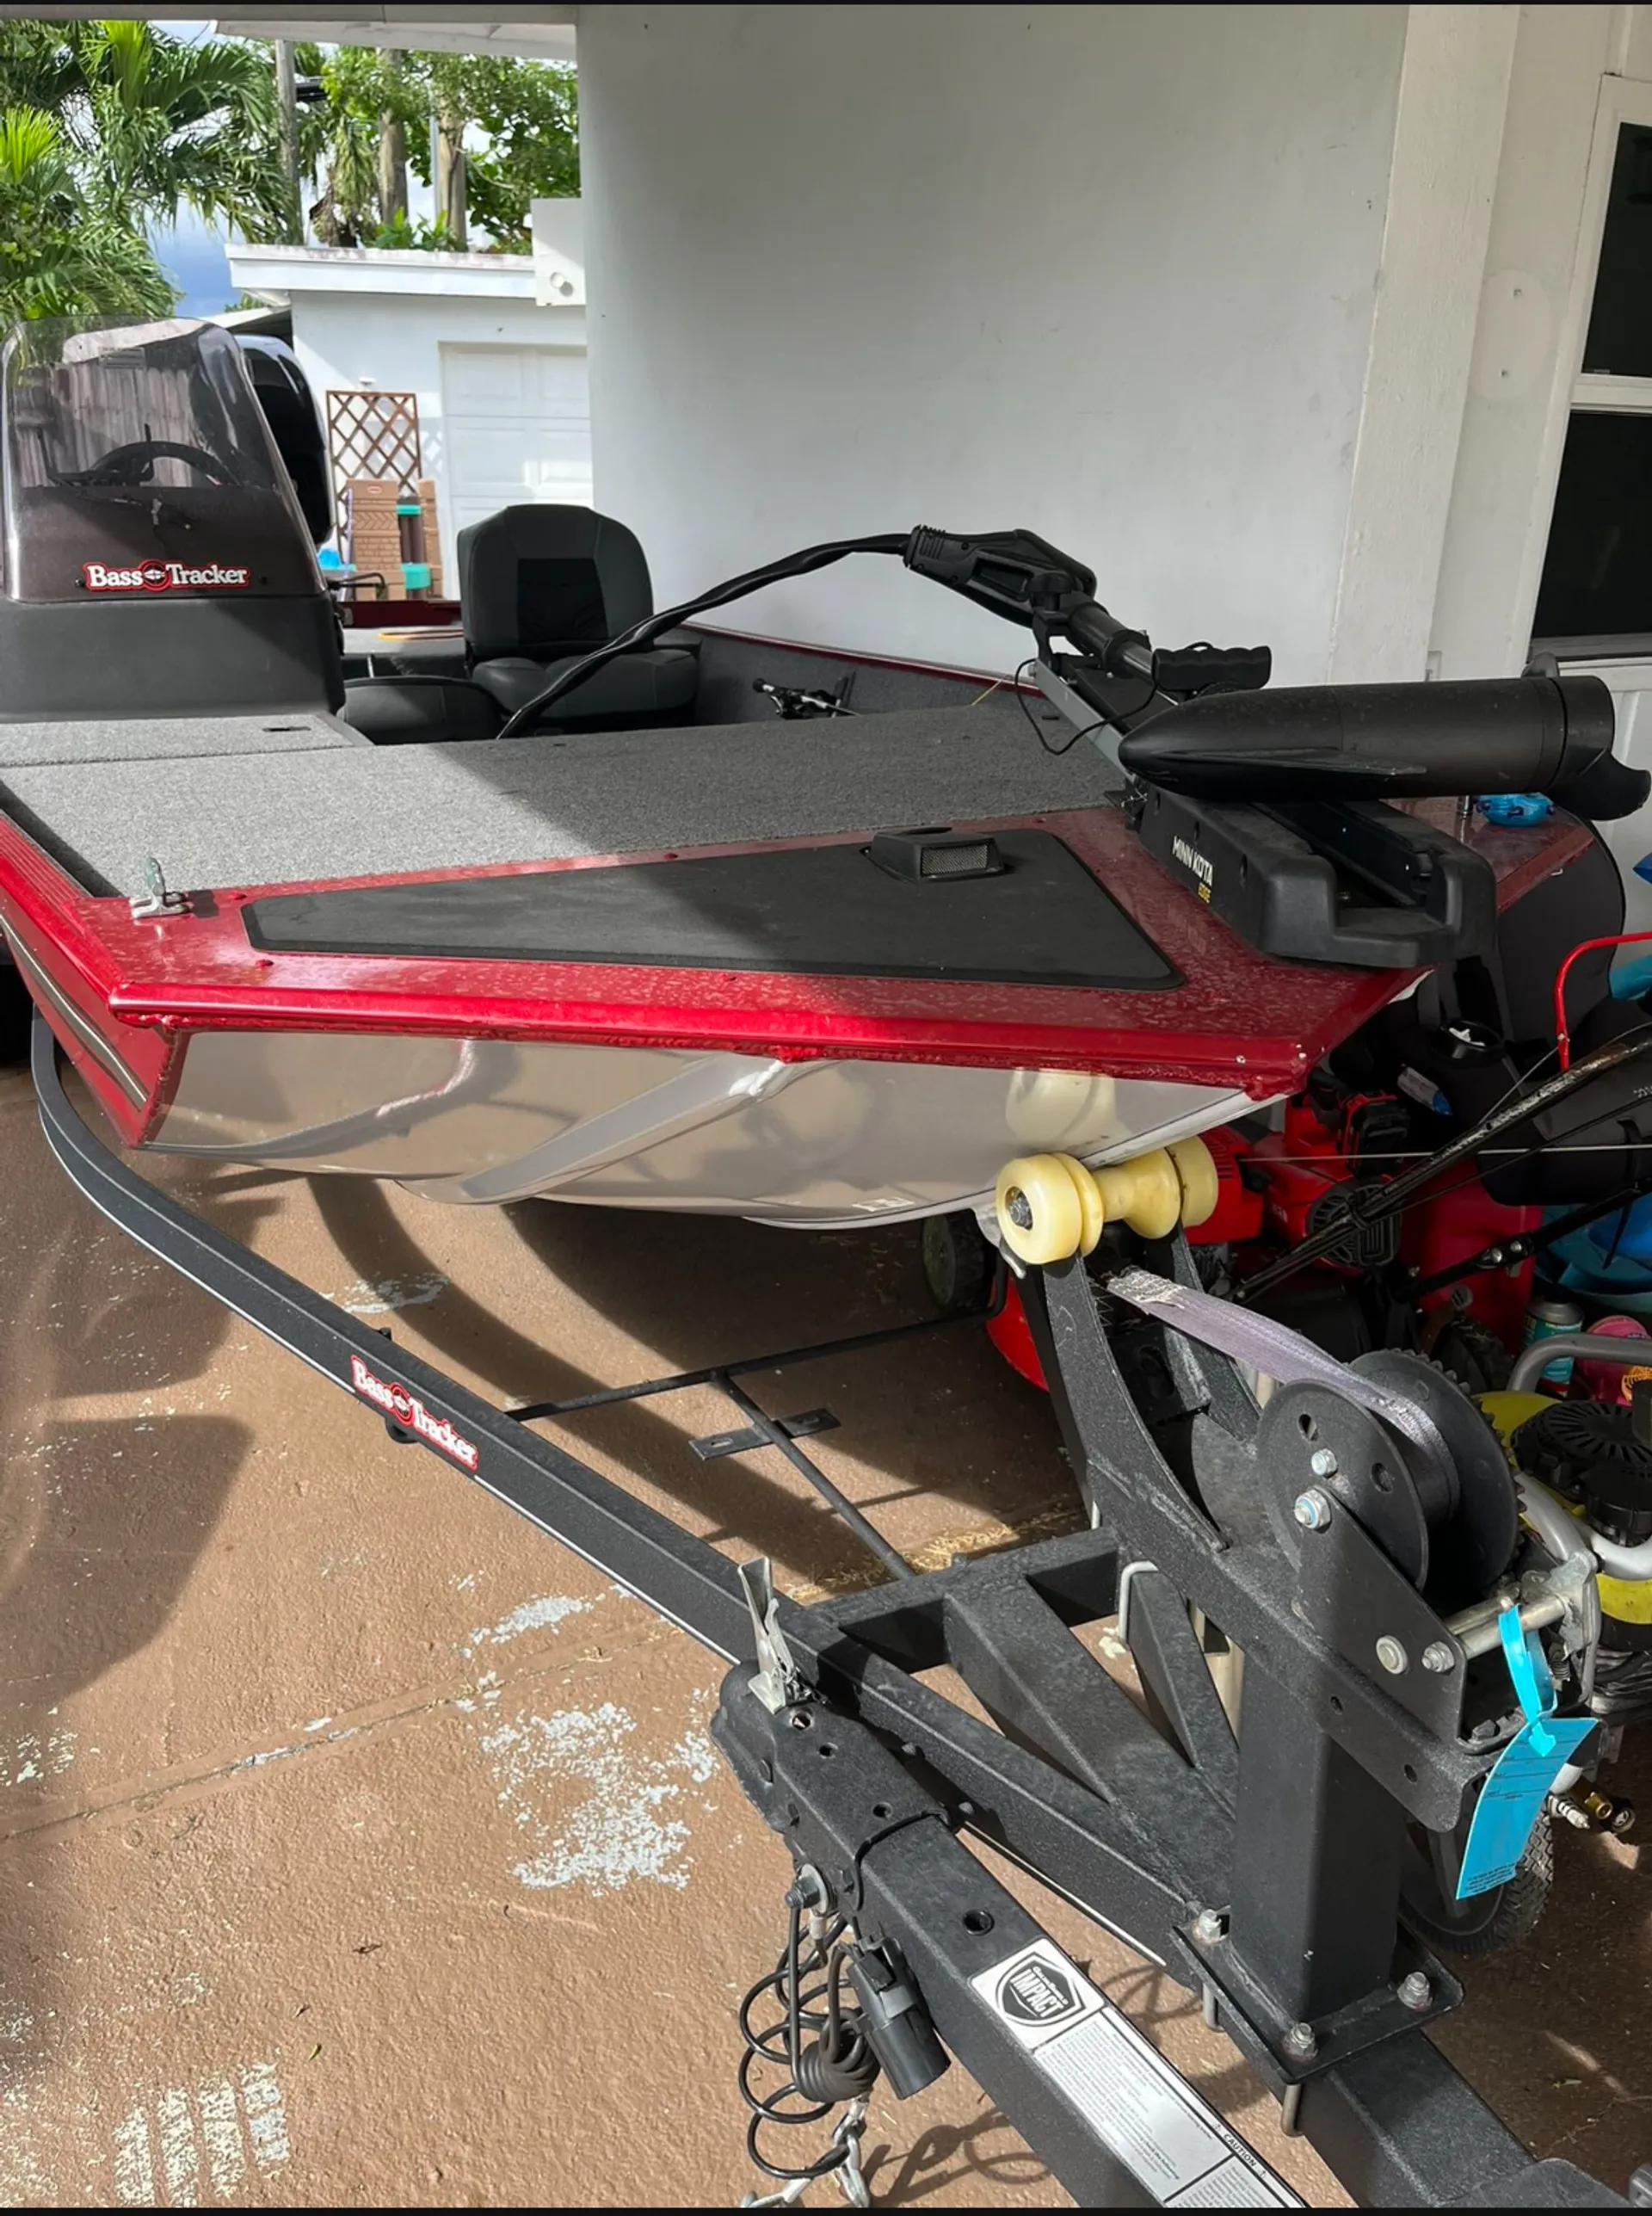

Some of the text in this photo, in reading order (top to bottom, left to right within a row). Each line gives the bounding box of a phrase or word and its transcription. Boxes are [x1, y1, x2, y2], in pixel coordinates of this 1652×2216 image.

[87, 564, 247, 587] Bass Tracker
[1172, 835, 1214, 887] MINN KOTA
[352, 1358, 478, 1466] Bass Tracker
[1009, 1968, 1065, 2018] IMPACT
[1224, 2133, 1257, 2167] CAUTION
